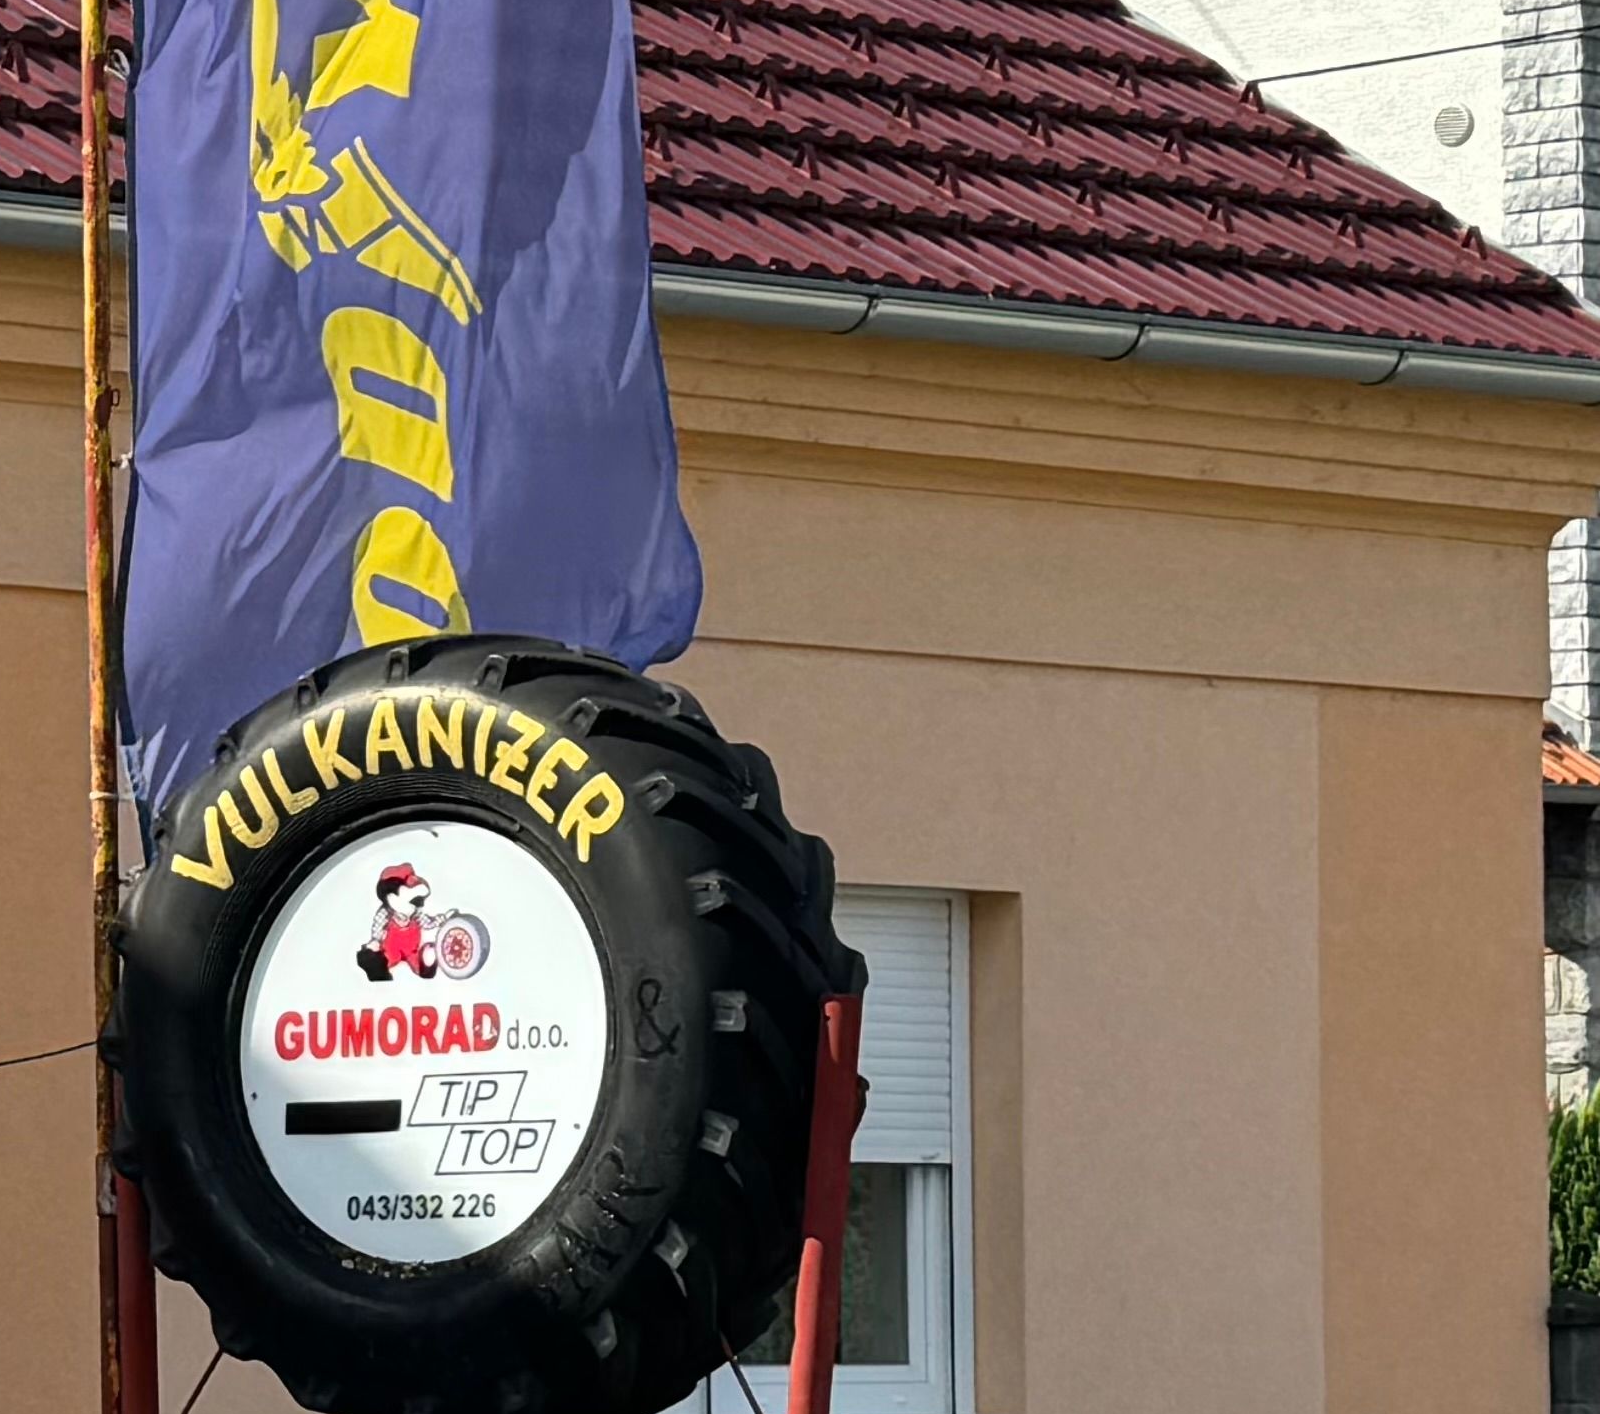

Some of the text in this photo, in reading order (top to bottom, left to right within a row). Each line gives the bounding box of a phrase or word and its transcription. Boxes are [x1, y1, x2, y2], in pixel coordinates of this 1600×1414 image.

[170, 697, 625, 891] VULKANIZER
[274, 1002, 569, 1061] GUMORAD d.o.o.
[439, 1079, 499, 1118] TIP
[459, 1128, 539, 1167] TOP
[347, 1193, 496, 1221] 043/332 226
